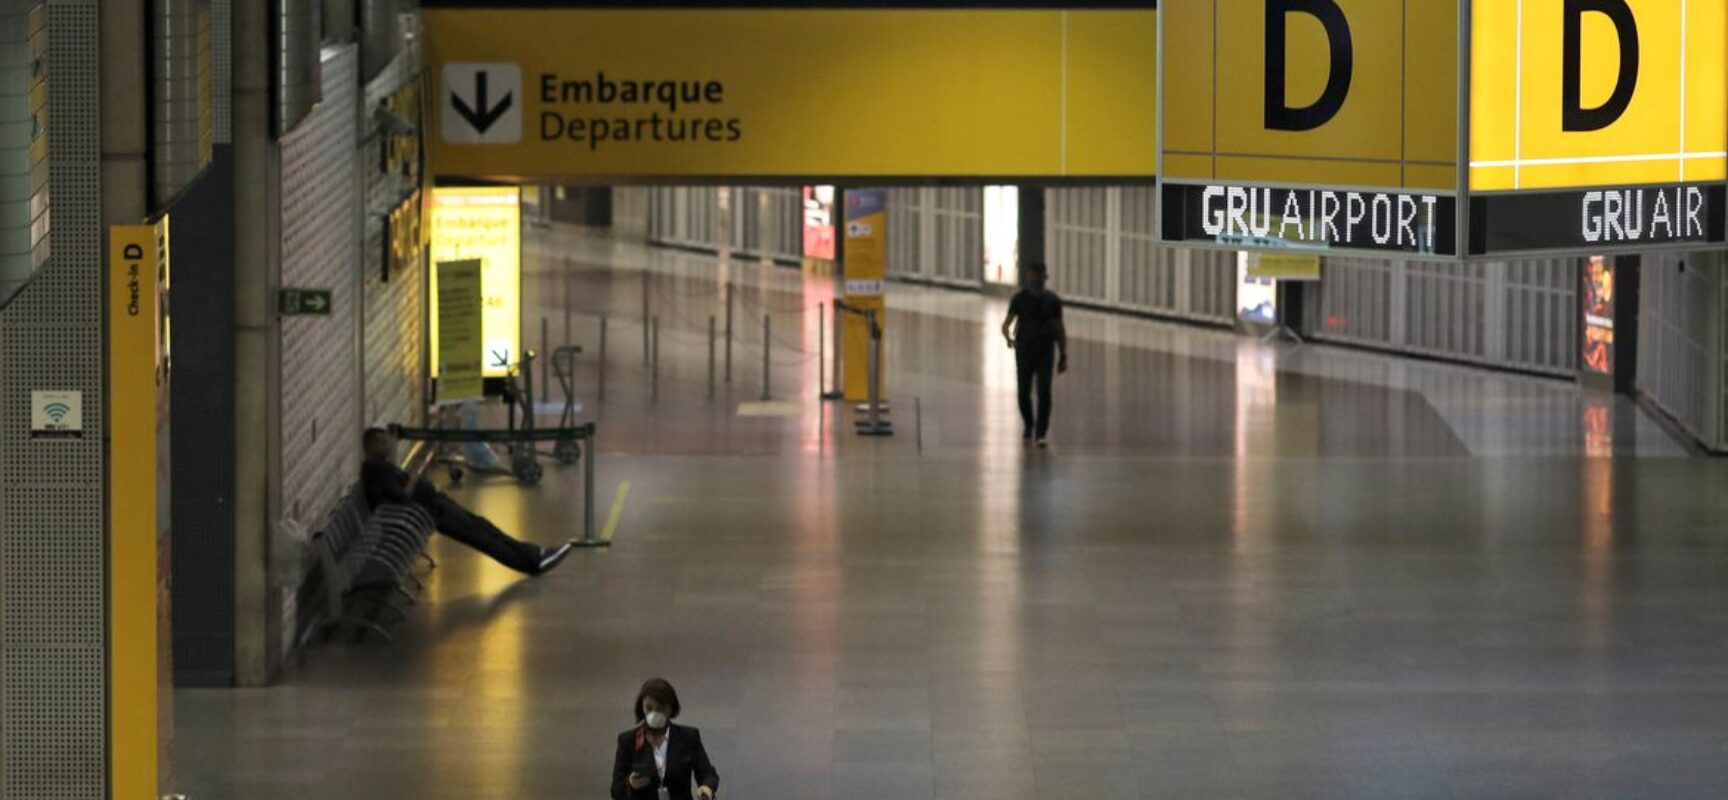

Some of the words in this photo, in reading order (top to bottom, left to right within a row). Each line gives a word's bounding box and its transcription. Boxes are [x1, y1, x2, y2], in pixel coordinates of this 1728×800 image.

[540, 72, 724, 113] Embarque
[1264, 0, 1353, 131] D
[1562, 0, 1640, 131] D
[540, 111, 742, 151] Departures
[1202, 185, 1271, 238] GRU
[1279, 189, 1437, 247] AIRPORT
[1582, 189, 1643, 242] GRU
[1650, 186, 1703, 239] AIR
[124, 243, 143, 260] D
[128, 264, 139, 317] Check-in
